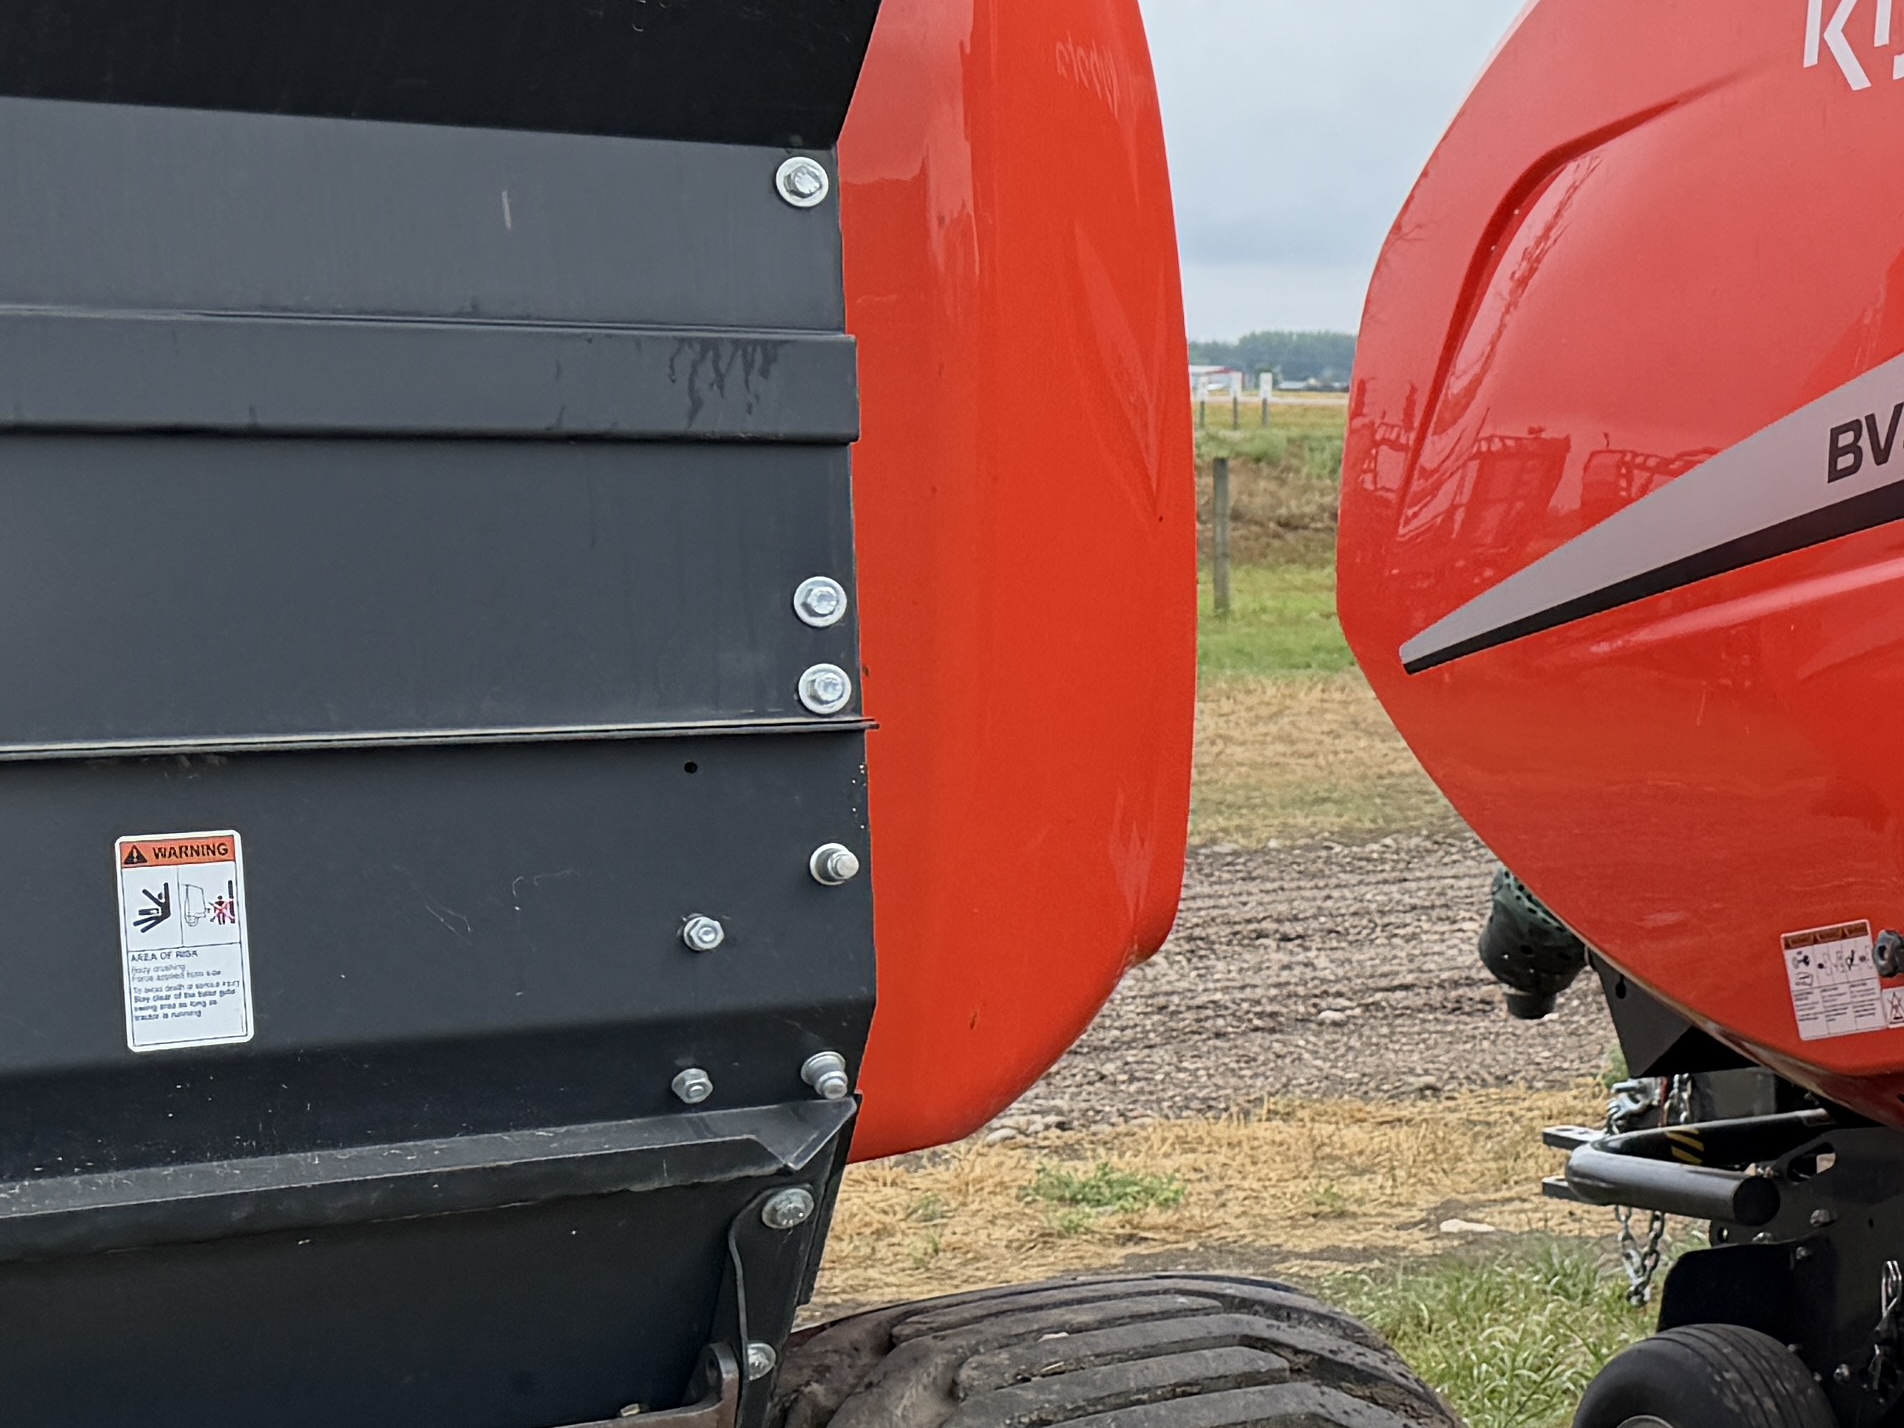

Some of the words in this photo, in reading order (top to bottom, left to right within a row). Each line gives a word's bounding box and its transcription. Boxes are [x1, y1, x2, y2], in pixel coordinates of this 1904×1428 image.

[152, 842, 229, 860] WARNING
[131, 953, 157, 962] AREA
[160, 952, 171, 960] OF
